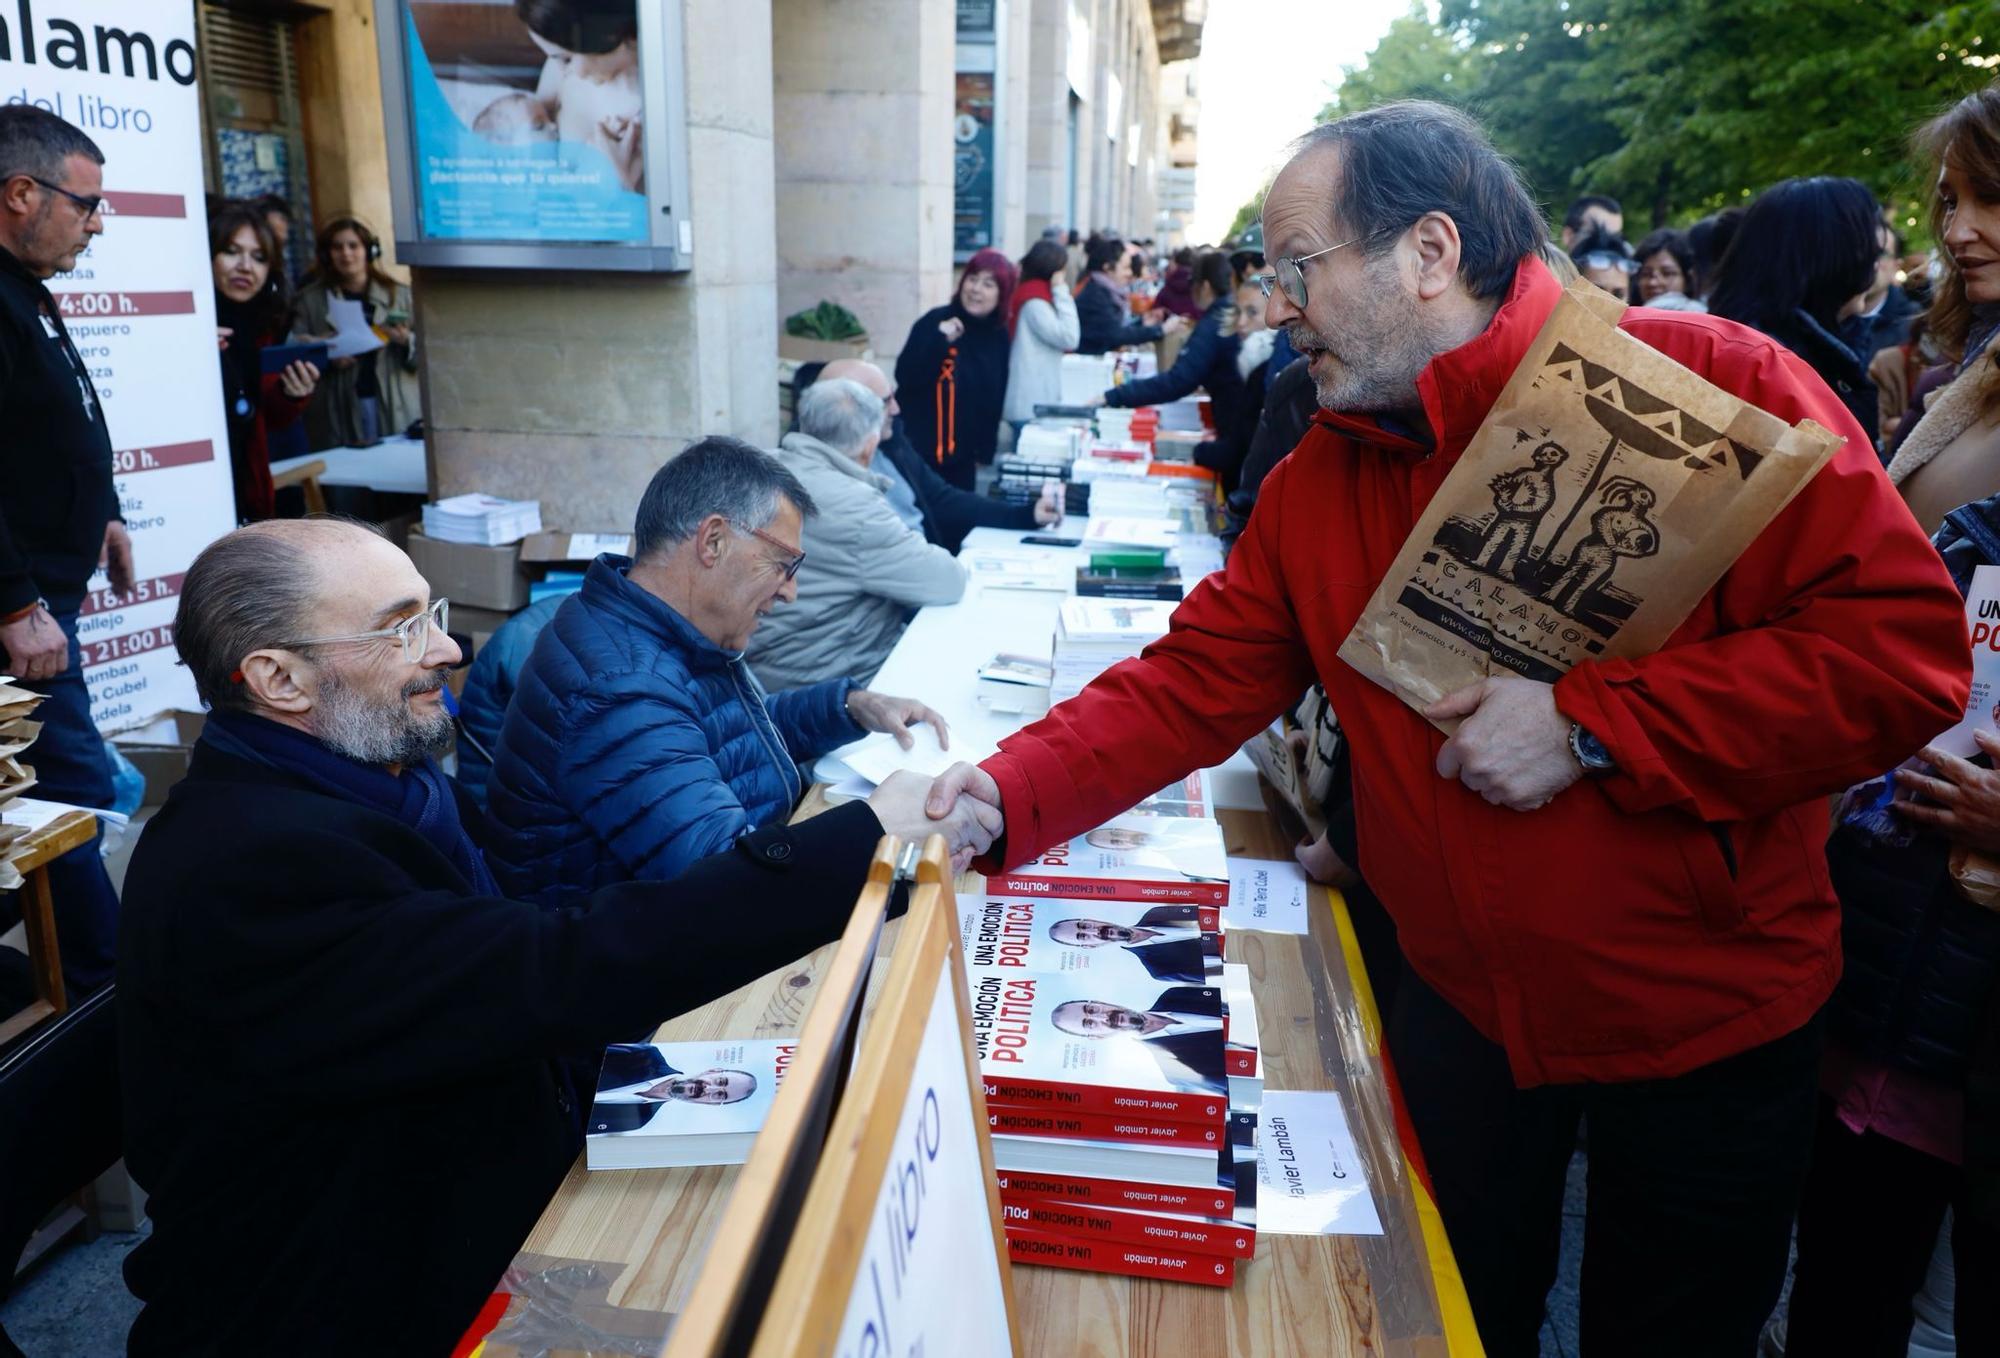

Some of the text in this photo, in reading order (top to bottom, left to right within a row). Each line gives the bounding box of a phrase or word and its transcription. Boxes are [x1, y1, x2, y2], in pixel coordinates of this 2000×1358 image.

[0, 0, 197, 86] lamo
[78, 94, 152, 133] libro
[119, 293, 139, 314] h.
[141, 450, 160, 468] h.
[156, 579, 174, 595] h.
[1441, 561, 1584, 644] CALAMO
[96, 630, 155, 661] 21:00
[103, 677, 147, 699] Cubel
[1007, 880, 1049, 892] POLÍTICA
[1051, 882, 1093, 894] EMOCIÓN
[1094, 884, 1116, 895] UNA
[1170, 888, 1193, 898] Javier
[973, 902, 1004, 966] UNA EMOCIÓN
[997, 904, 1035, 967] POLÍTICA
[973, 976, 1002, 1029] EMOCIÓN
[991, 980, 1037, 1063] POLÍTICA
[1001, 1085, 1054, 1100] EMOCIÓN
[1056, 1091, 1081, 1103] UNA
[1151, 1100, 1178, 1111] Javier
[1001, 1115, 1054, 1130] EMOCIÓN
[1056, 1120, 1081, 1132] UNA
[1151, 1125, 1178, 1137] Javier
[1268, 1117, 1296, 1162] Lambán
[886, 1087, 940, 1300] libro
[1011, 1179, 1064, 1194] EMOCIÓN
[1067, 1185, 1091, 1197] UNA
[1160, 1194, 1187, 1205] Javier
[1032, 1211, 1085, 1228] EMOCIÓN
[1088, 1219, 1112, 1231] UNA
[1180, 1231, 1208, 1243] Javier
[1012, 1238, 1065, 1257] EMOCIÓN
[1068, 1247, 1092, 1259] UNA
[1160, 1258, 1187, 1269] Javier
